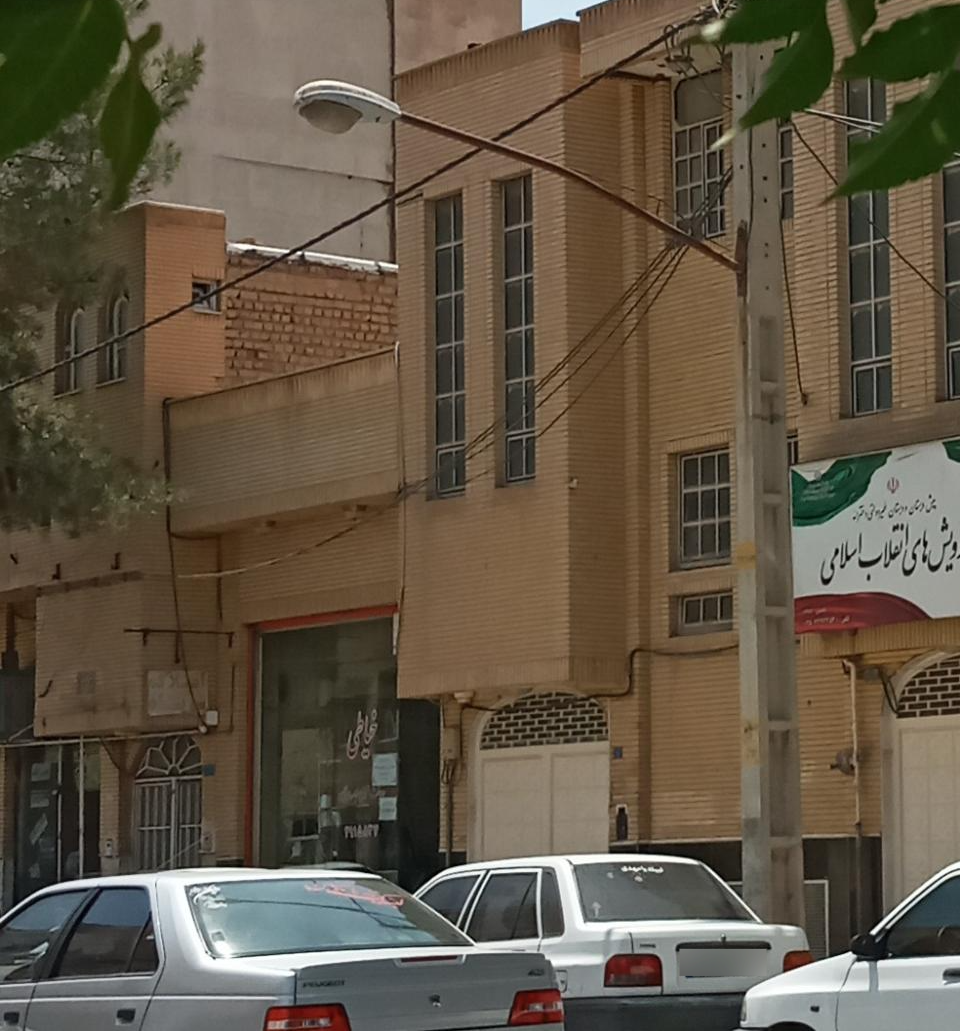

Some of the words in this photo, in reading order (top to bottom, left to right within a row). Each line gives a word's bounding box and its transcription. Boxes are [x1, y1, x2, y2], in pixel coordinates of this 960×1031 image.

[820, 532, 863, 586] اسلامی
[858, 522, 910, 581] انقلاب
[346, 709, 378, 760] خیاطی
[303, 979, 345, 988] PEUGEOT
